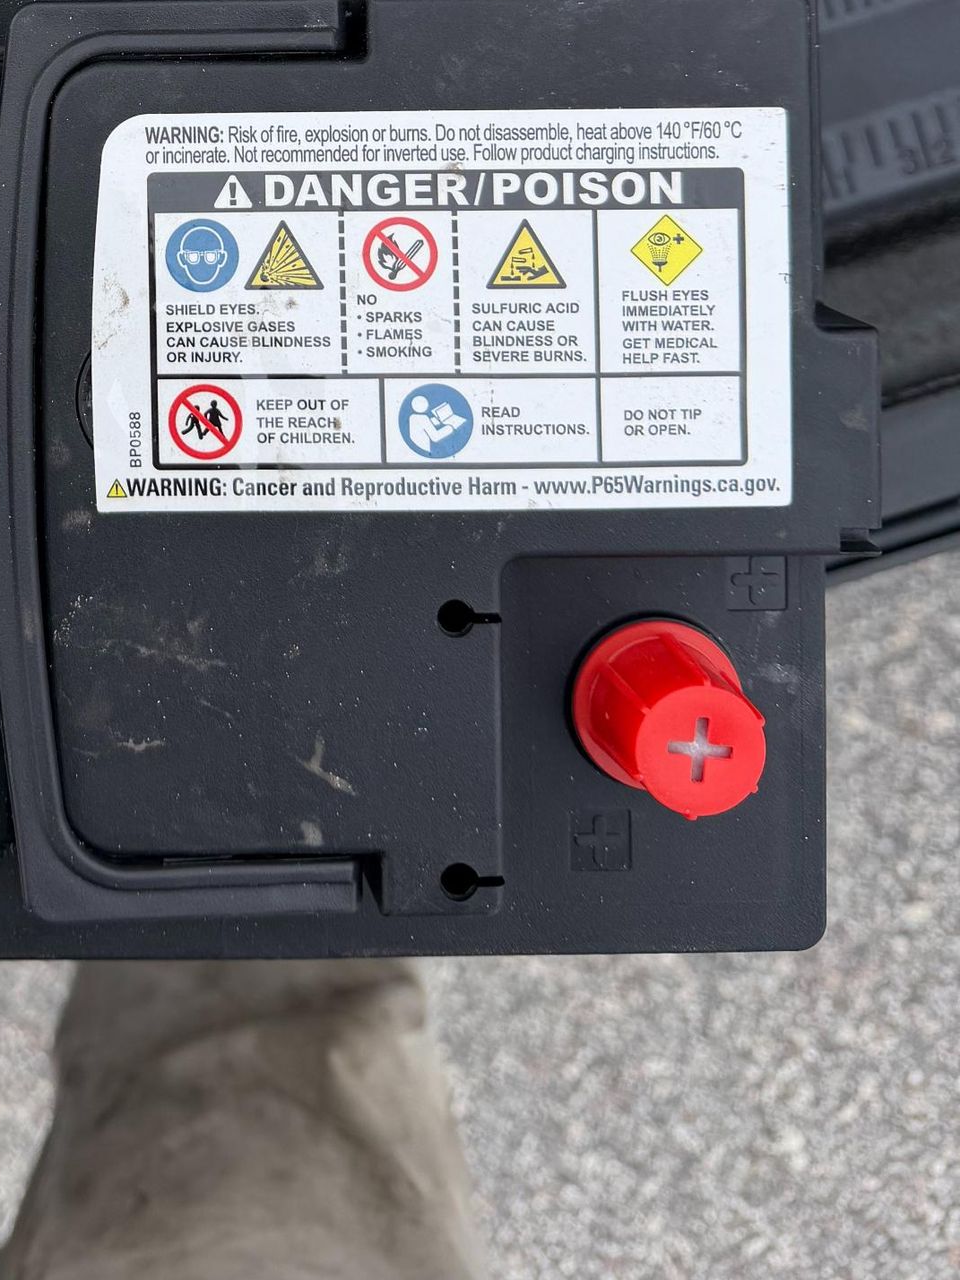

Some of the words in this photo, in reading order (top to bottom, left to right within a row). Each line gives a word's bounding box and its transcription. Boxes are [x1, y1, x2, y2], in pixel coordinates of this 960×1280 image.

[265, 171, 683, 207] DANGER/POISON
[357, 294, 377, 305] NO
[622, 291, 668, 301] FLUSH
[672, 290, 709, 301] EYES
[166, 304, 215, 316] SHIELD
[219, 304, 260, 315] EYES.
[472, 303, 543, 314] SULFURIC
[546, 302, 579, 313] ACID
[366, 312, 422, 323] SPARKS
[366, 329, 423, 340] FLAMES
[366, 346, 432, 358] SMOKING
[256, 400, 293, 411] KEEP
[297, 400, 326, 411] OUT
[331, 399, 349, 410] OF
[482, 407, 520, 418] READ
[624, 410, 644, 421] DO
[648, 409, 680, 420] NOT
[684, 409, 702, 420] TIP
[482, 424, 589, 435] INSTRUCTIONS.
[624, 425, 644, 436] OR
[648, 424, 690, 435] OPEN.
[130, 412, 142, 467] BP0588
[126, 478, 227, 498] WARNING:
[232, 478, 297, 497] Cancer
[302, 478, 336, 497] and
[341, 476, 462, 497] Reproductive
[468, 477, 517, 495] Harm
